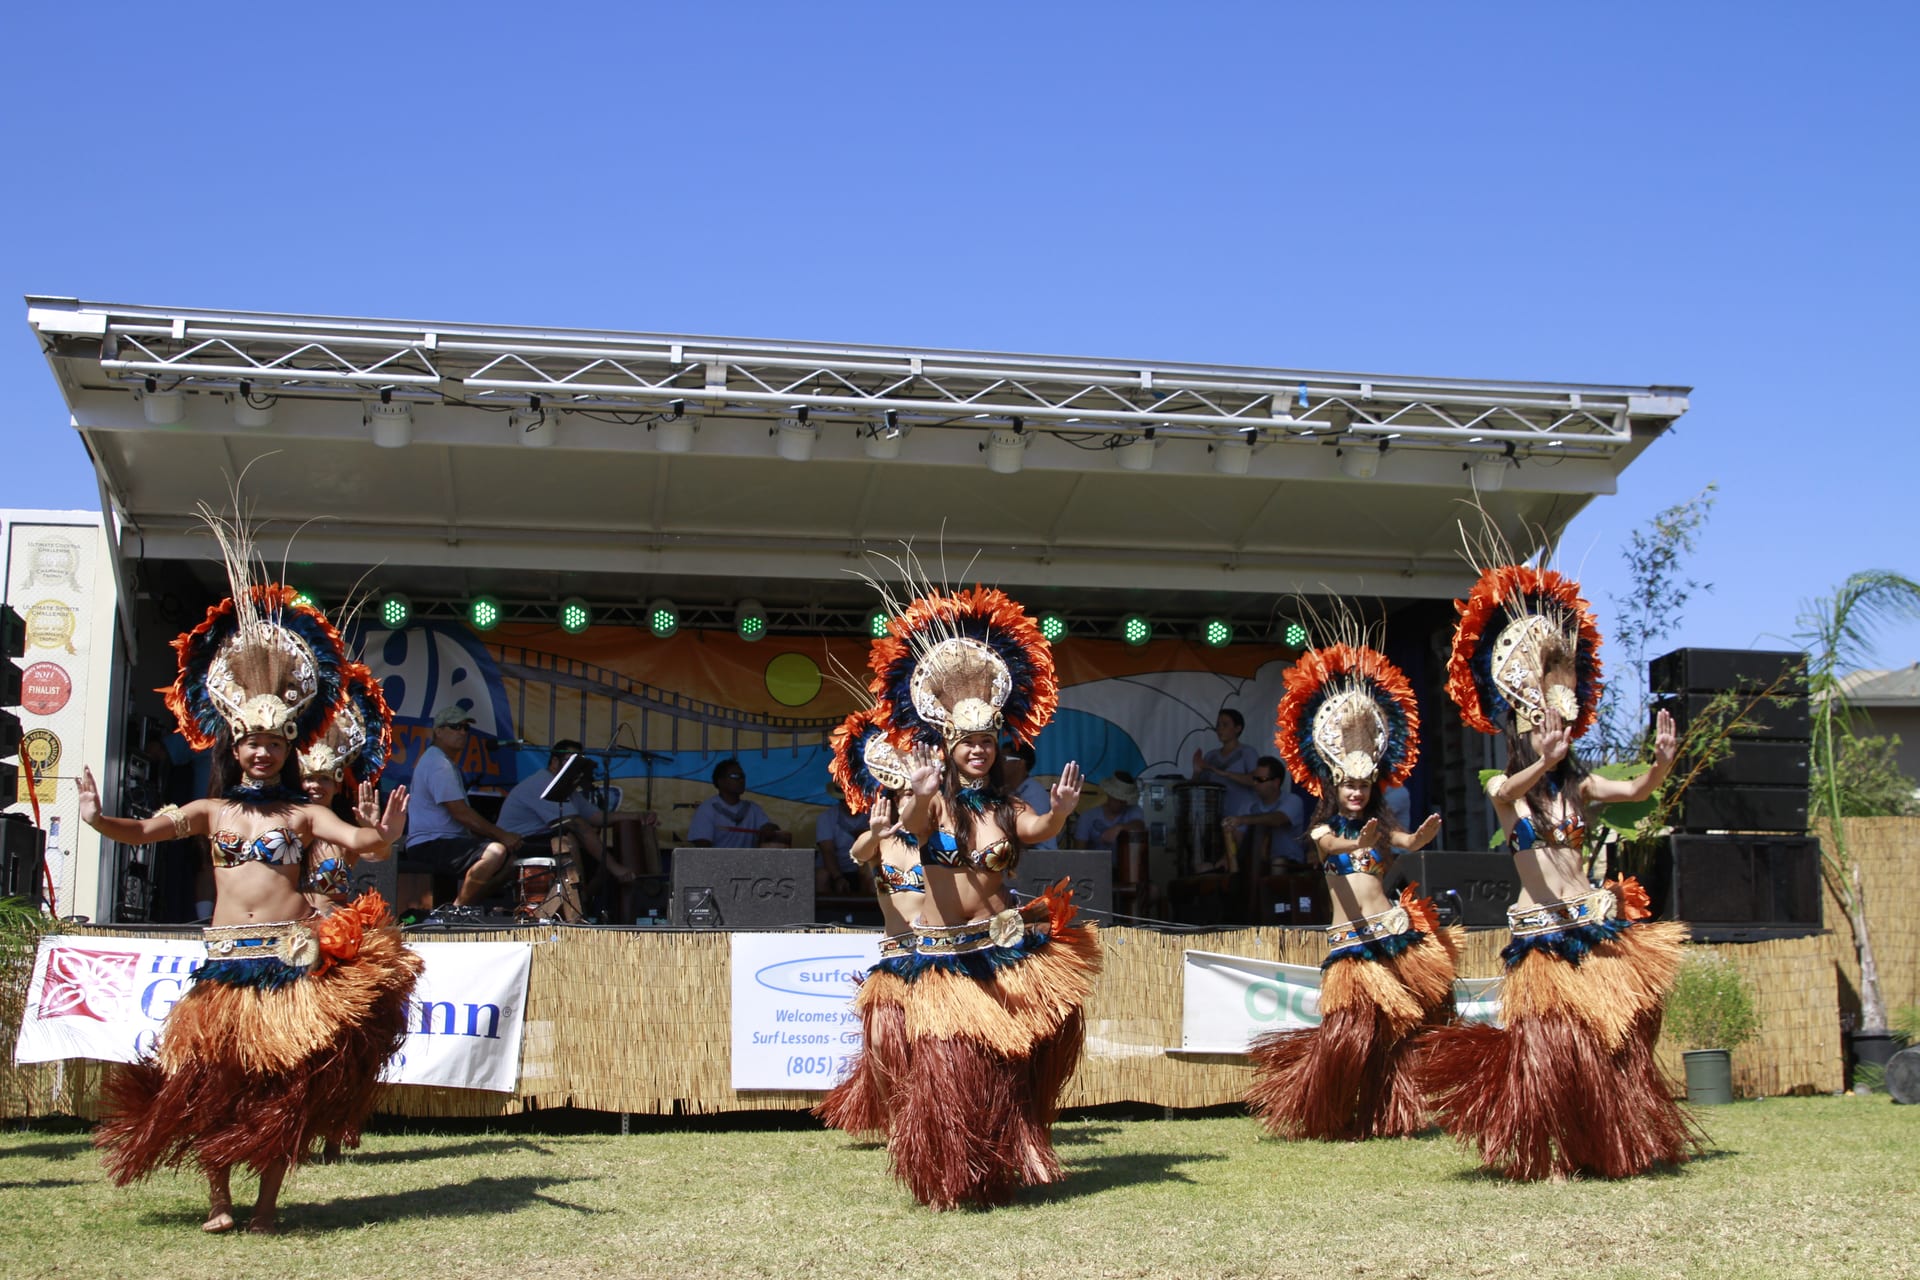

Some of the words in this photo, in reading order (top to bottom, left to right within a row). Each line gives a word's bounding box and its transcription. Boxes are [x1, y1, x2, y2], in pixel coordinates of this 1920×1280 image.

[28, 685, 61, 695] FINALIST
[729, 877, 796, 902] TCS
[1033, 877, 1096, 901] TS
[402, 993, 501, 1040] nn
[776, 1009, 838, 1023] Welcomes
[752, 1030, 780, 1045] Surf
[781, 1031, 830, 1045] Lessons
[840, 1031, 864, 1048] Cor
[787, 1055, 833, 1078] (805)
